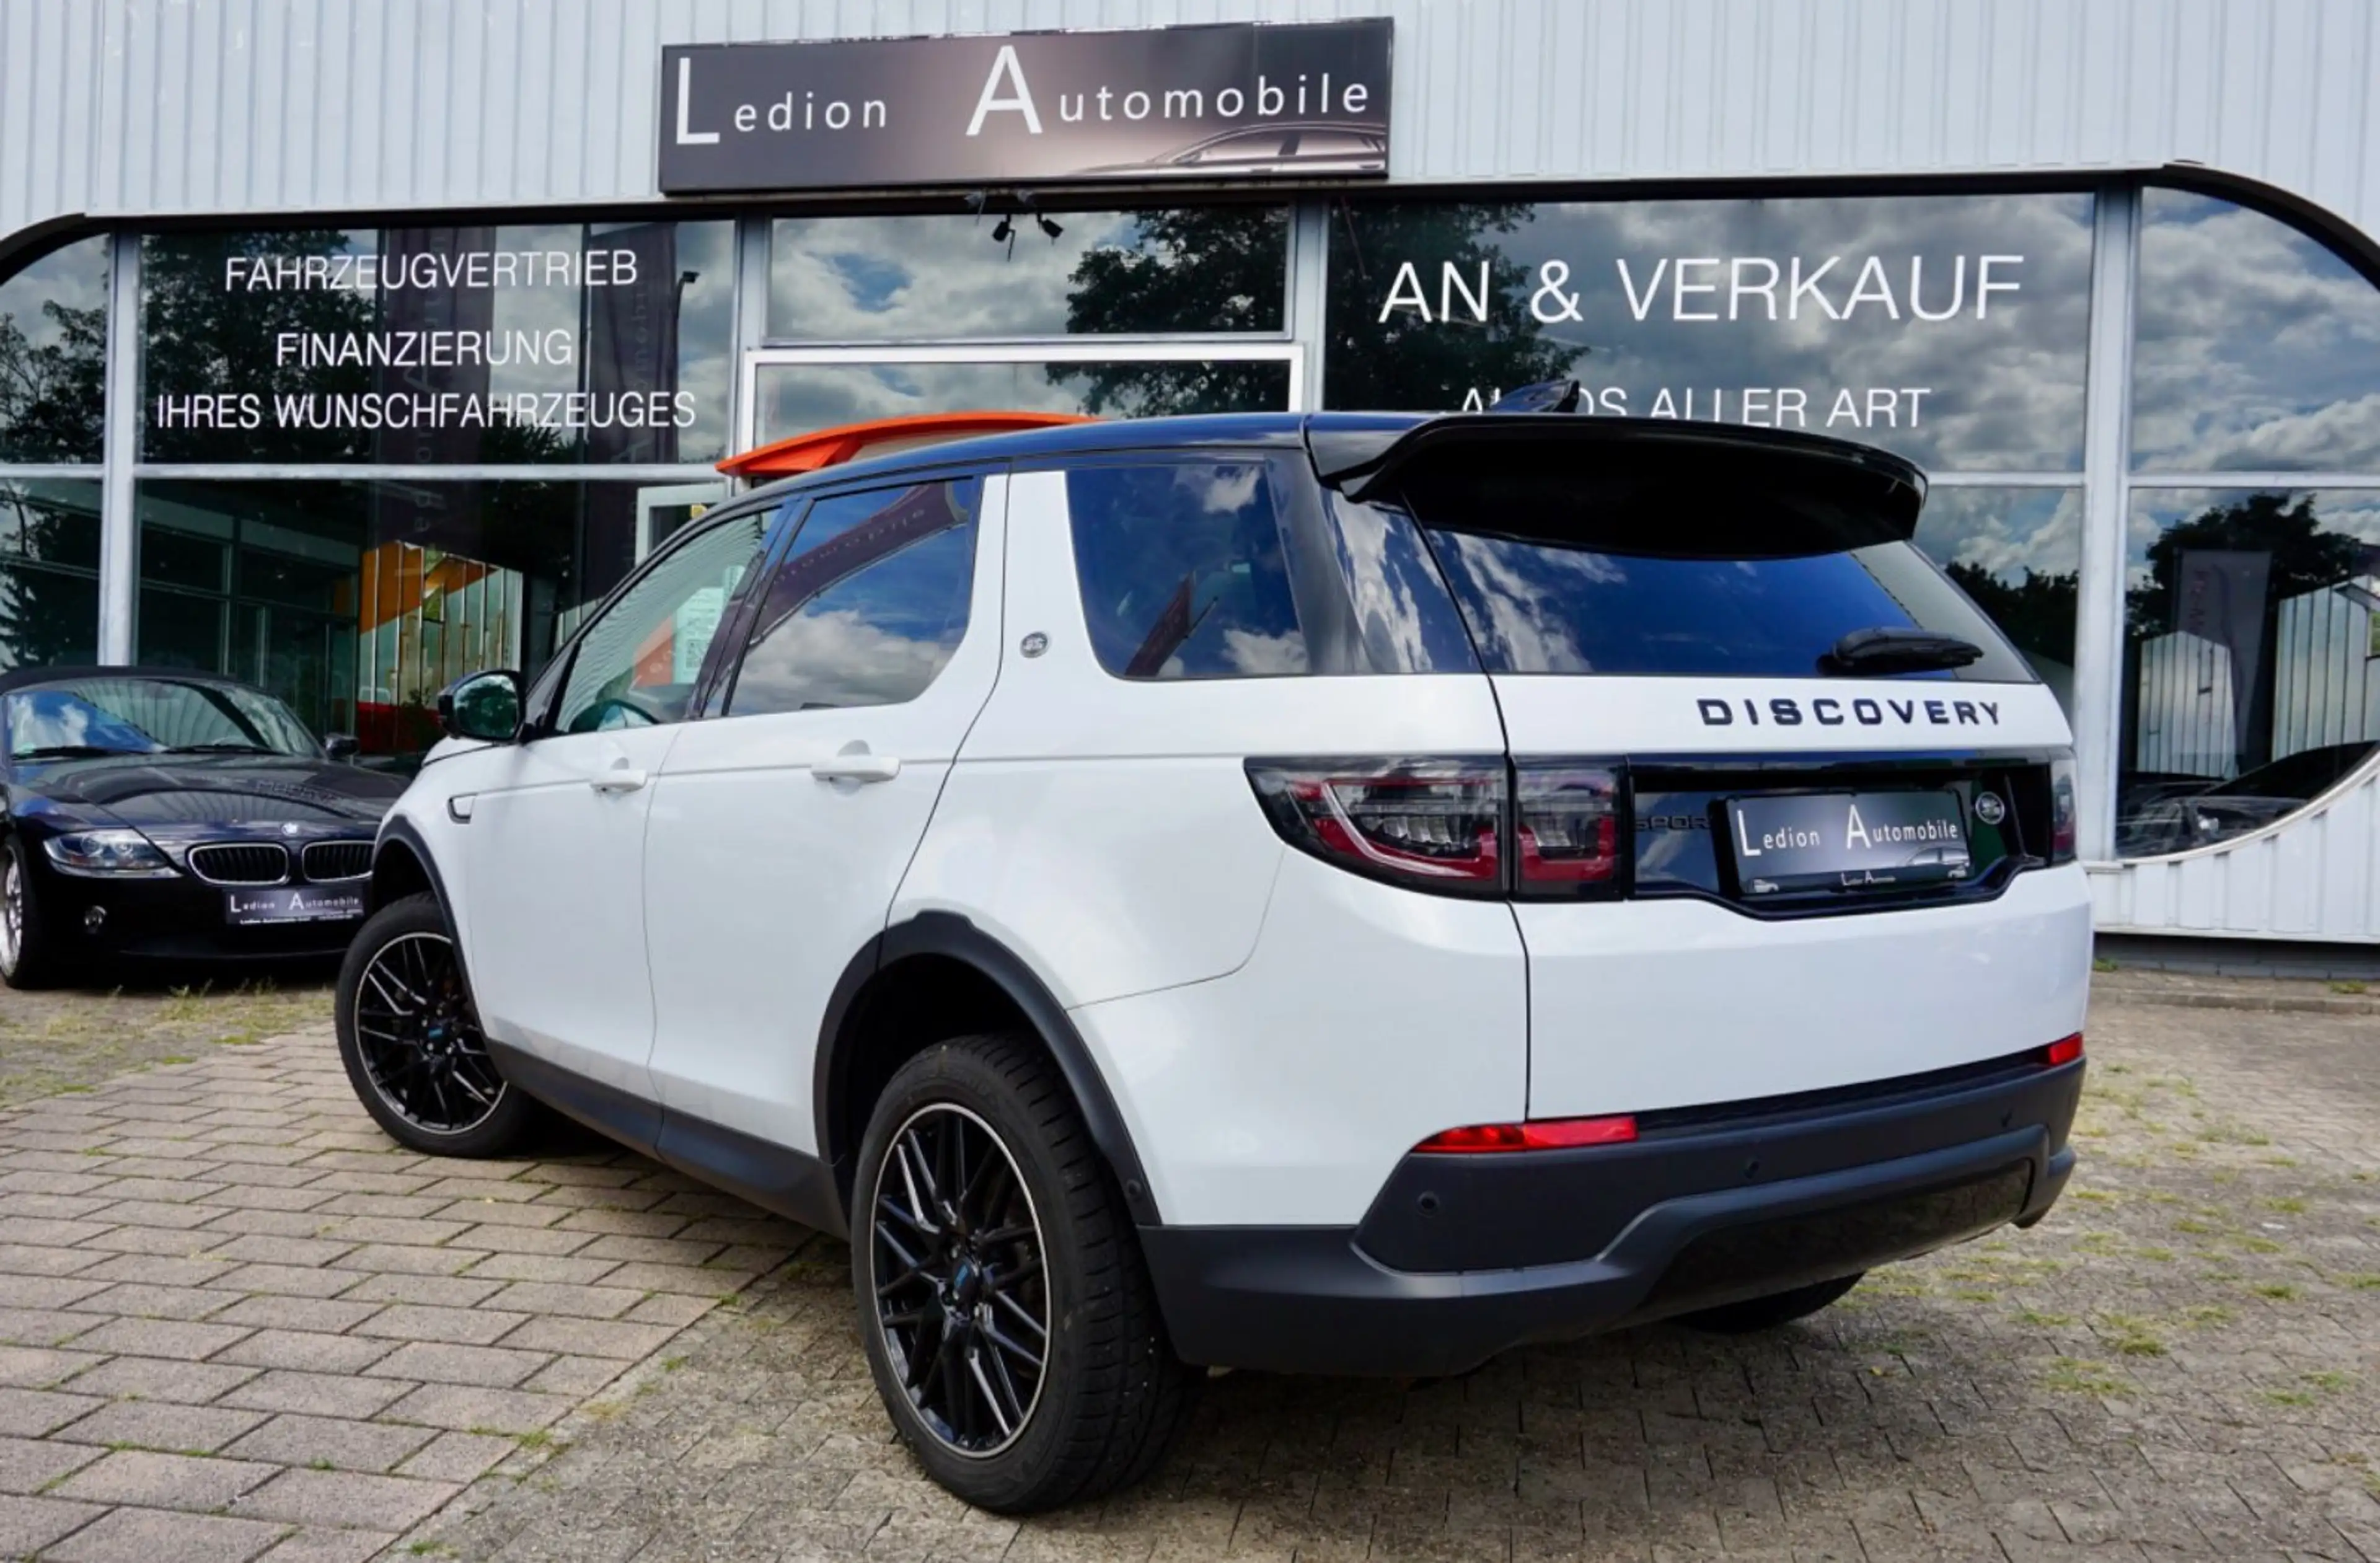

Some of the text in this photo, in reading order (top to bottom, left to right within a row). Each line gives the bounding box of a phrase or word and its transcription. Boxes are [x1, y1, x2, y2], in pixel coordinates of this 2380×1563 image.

[676, 45, 1368, 146] Ledion Automobile
[226, 250, 637, 290] FAHRZEUGVERTRIEB
[1378, 255, 2025, 323] AN & VERKAUF
[276, 328, 573, 366] FINANZIERUNG
[157, 390, 696, 428] IHRES WUNSCHFAHRZEUGES
[1825, 388, 1932, 428] ART
[1696, 698, 1999, 726] DISCOVERY
[1634, 816, 1712, 830] SPOR
[1737, 804, 1959, 856] Ledion Automobile
